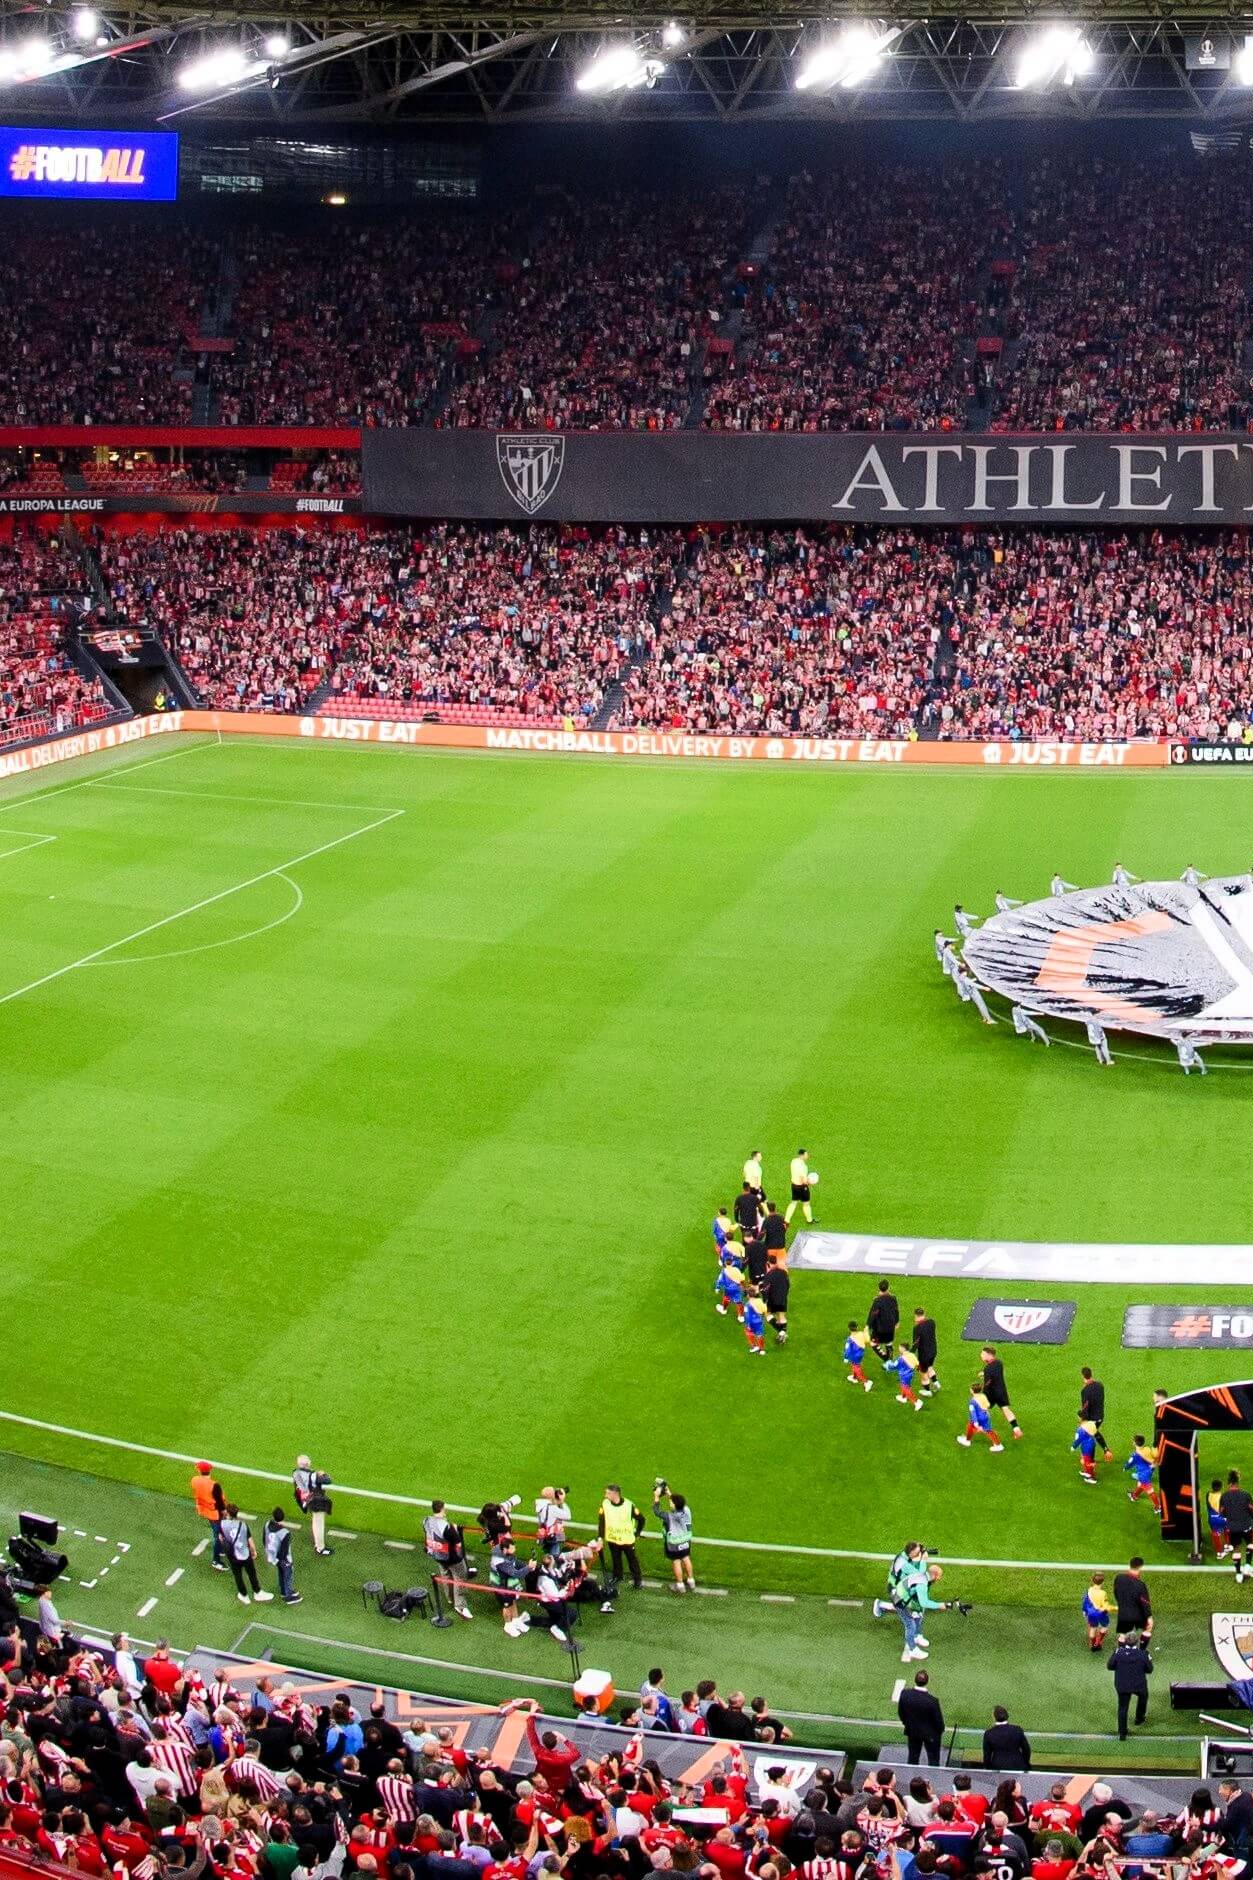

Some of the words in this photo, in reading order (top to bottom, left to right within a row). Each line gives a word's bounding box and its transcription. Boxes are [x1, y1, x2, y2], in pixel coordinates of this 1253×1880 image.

[10, 146, 144, 183] #FOOTBALL
[10, 500, 55, 511] EUROPA
[58, 499, 104, 510] LEAGUE
[296, 499, 344, 512] #FOOTBALL
[32, 735, 86, 769] DELIVERY
[88, 732, 101, 752] BY
[119, 716, 147, 744] JUST
[150, 711, 184, 733] EAT
[321, 717, 374, 741] JUST
[378, 721, 422, 744] EAT
[487, 727, 616, 753] MATCHBALL
[623, 734, 721, 757] DELIVERY
[729, 738, 755, 758] BY
[791, 740, 848, 761] JUST
[859, 740, 908, 762] EAT
[1009, 742, 1076, 765] JUST
[1079, 742, 1131, 764] EAT
[1192, 747, 1233, 762] UEFA
[801, 1236, 1019, 1273] UEFA
